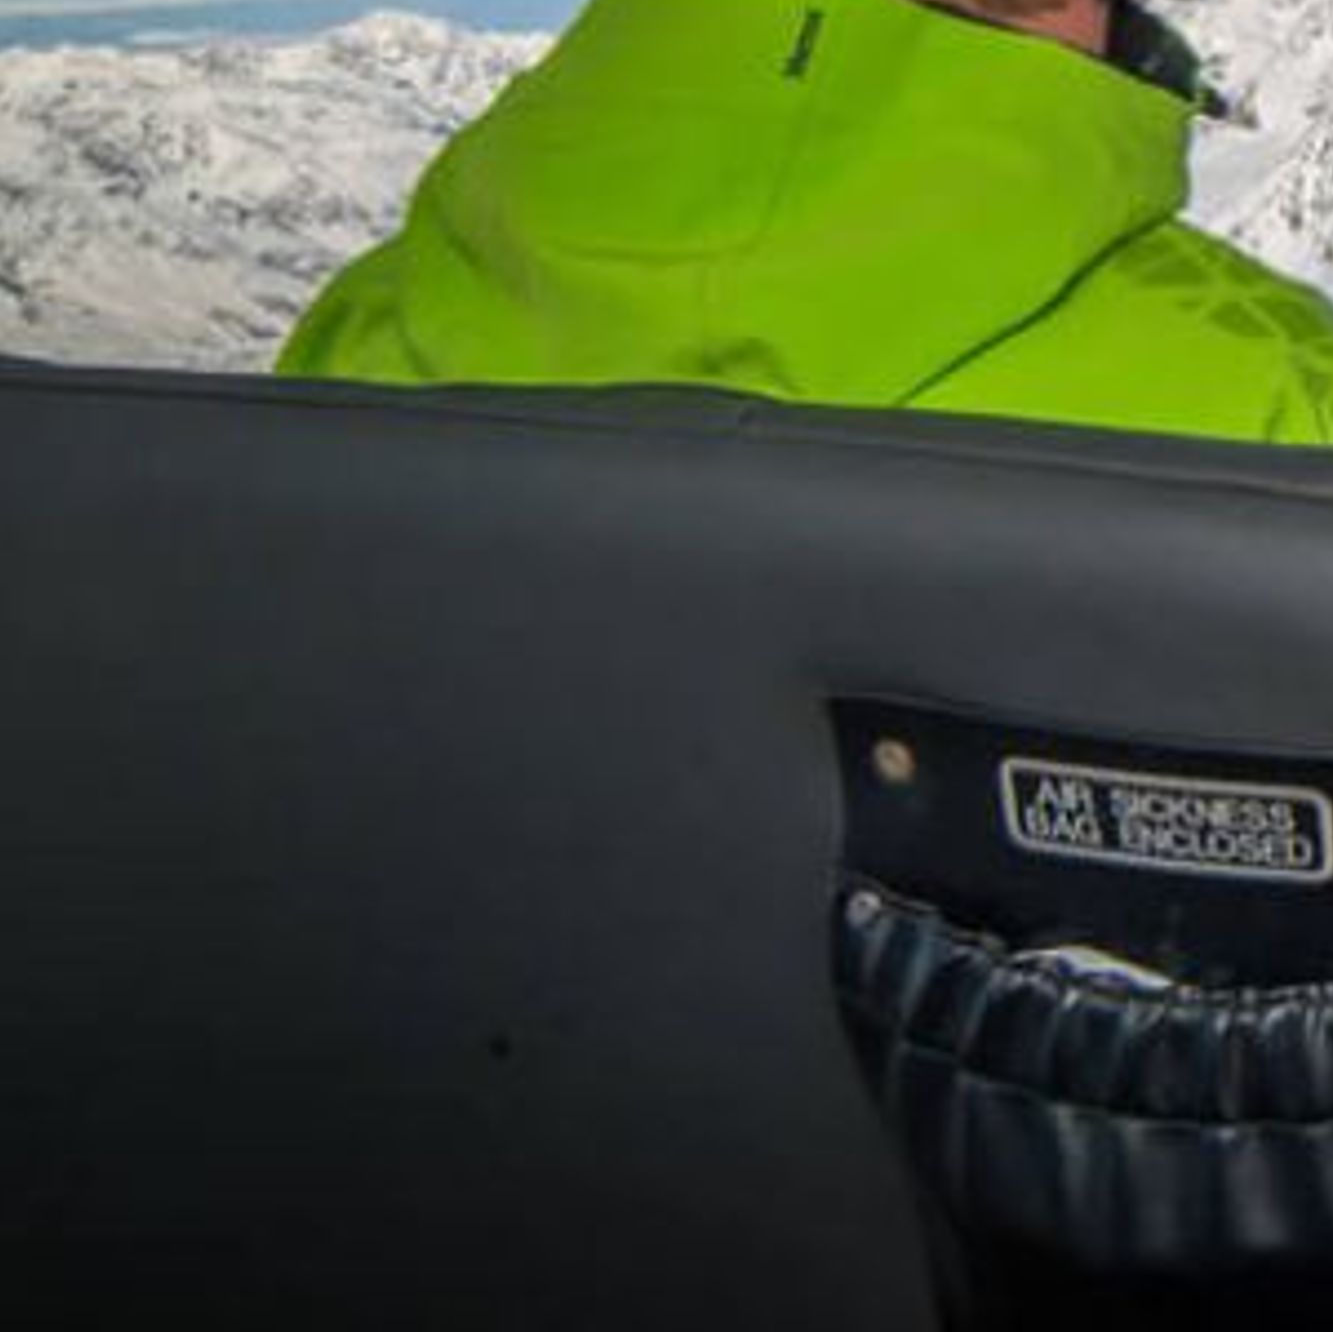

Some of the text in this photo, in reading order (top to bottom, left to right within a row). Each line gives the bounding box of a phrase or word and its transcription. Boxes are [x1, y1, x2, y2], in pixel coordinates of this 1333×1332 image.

[1035, 777, 1294, 831] AIR SICKNESS
[1024, 805, 1313, 868] BAG ENCLOSED
